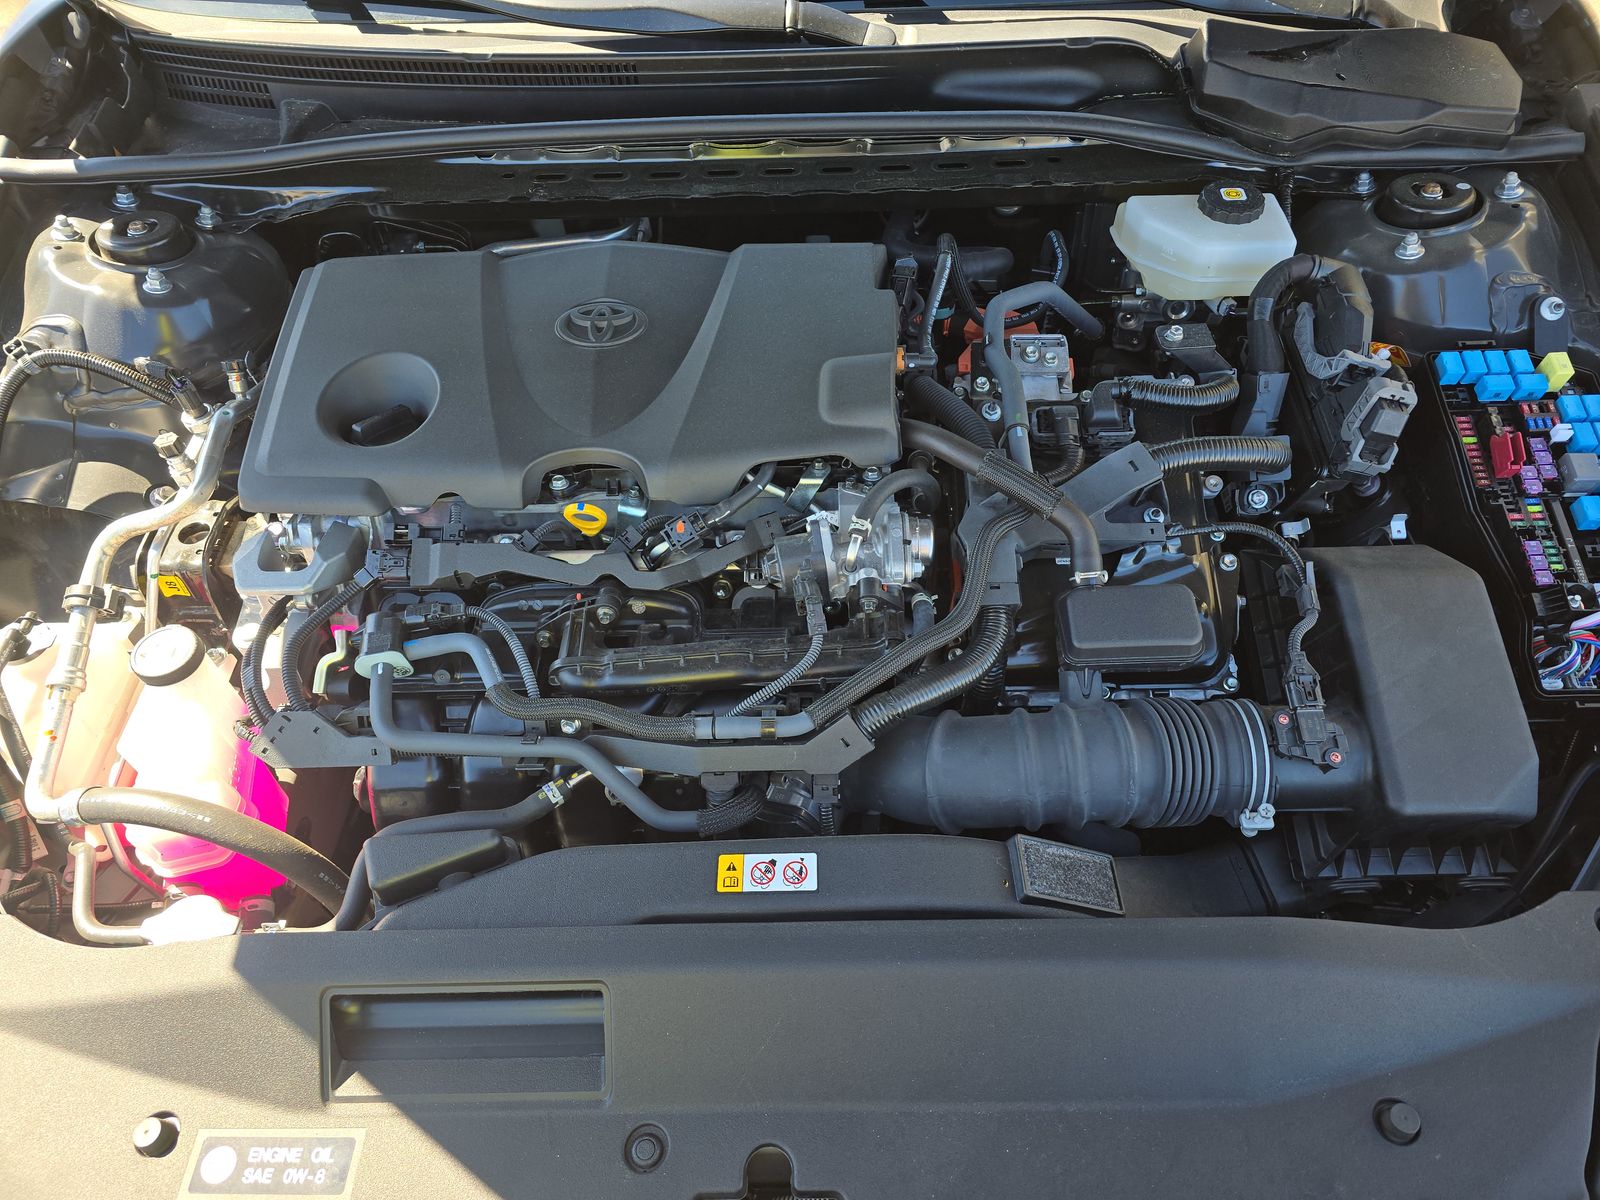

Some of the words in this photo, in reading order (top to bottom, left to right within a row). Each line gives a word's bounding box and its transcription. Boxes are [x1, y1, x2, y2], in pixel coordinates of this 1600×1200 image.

[248, 1147, 304, 1163] ENGINE
[311, 1147, 335, 1163] OIL
[241, 1168, 275, 1185] SAE
[282, 1168, 327, 1185] 0W-8
